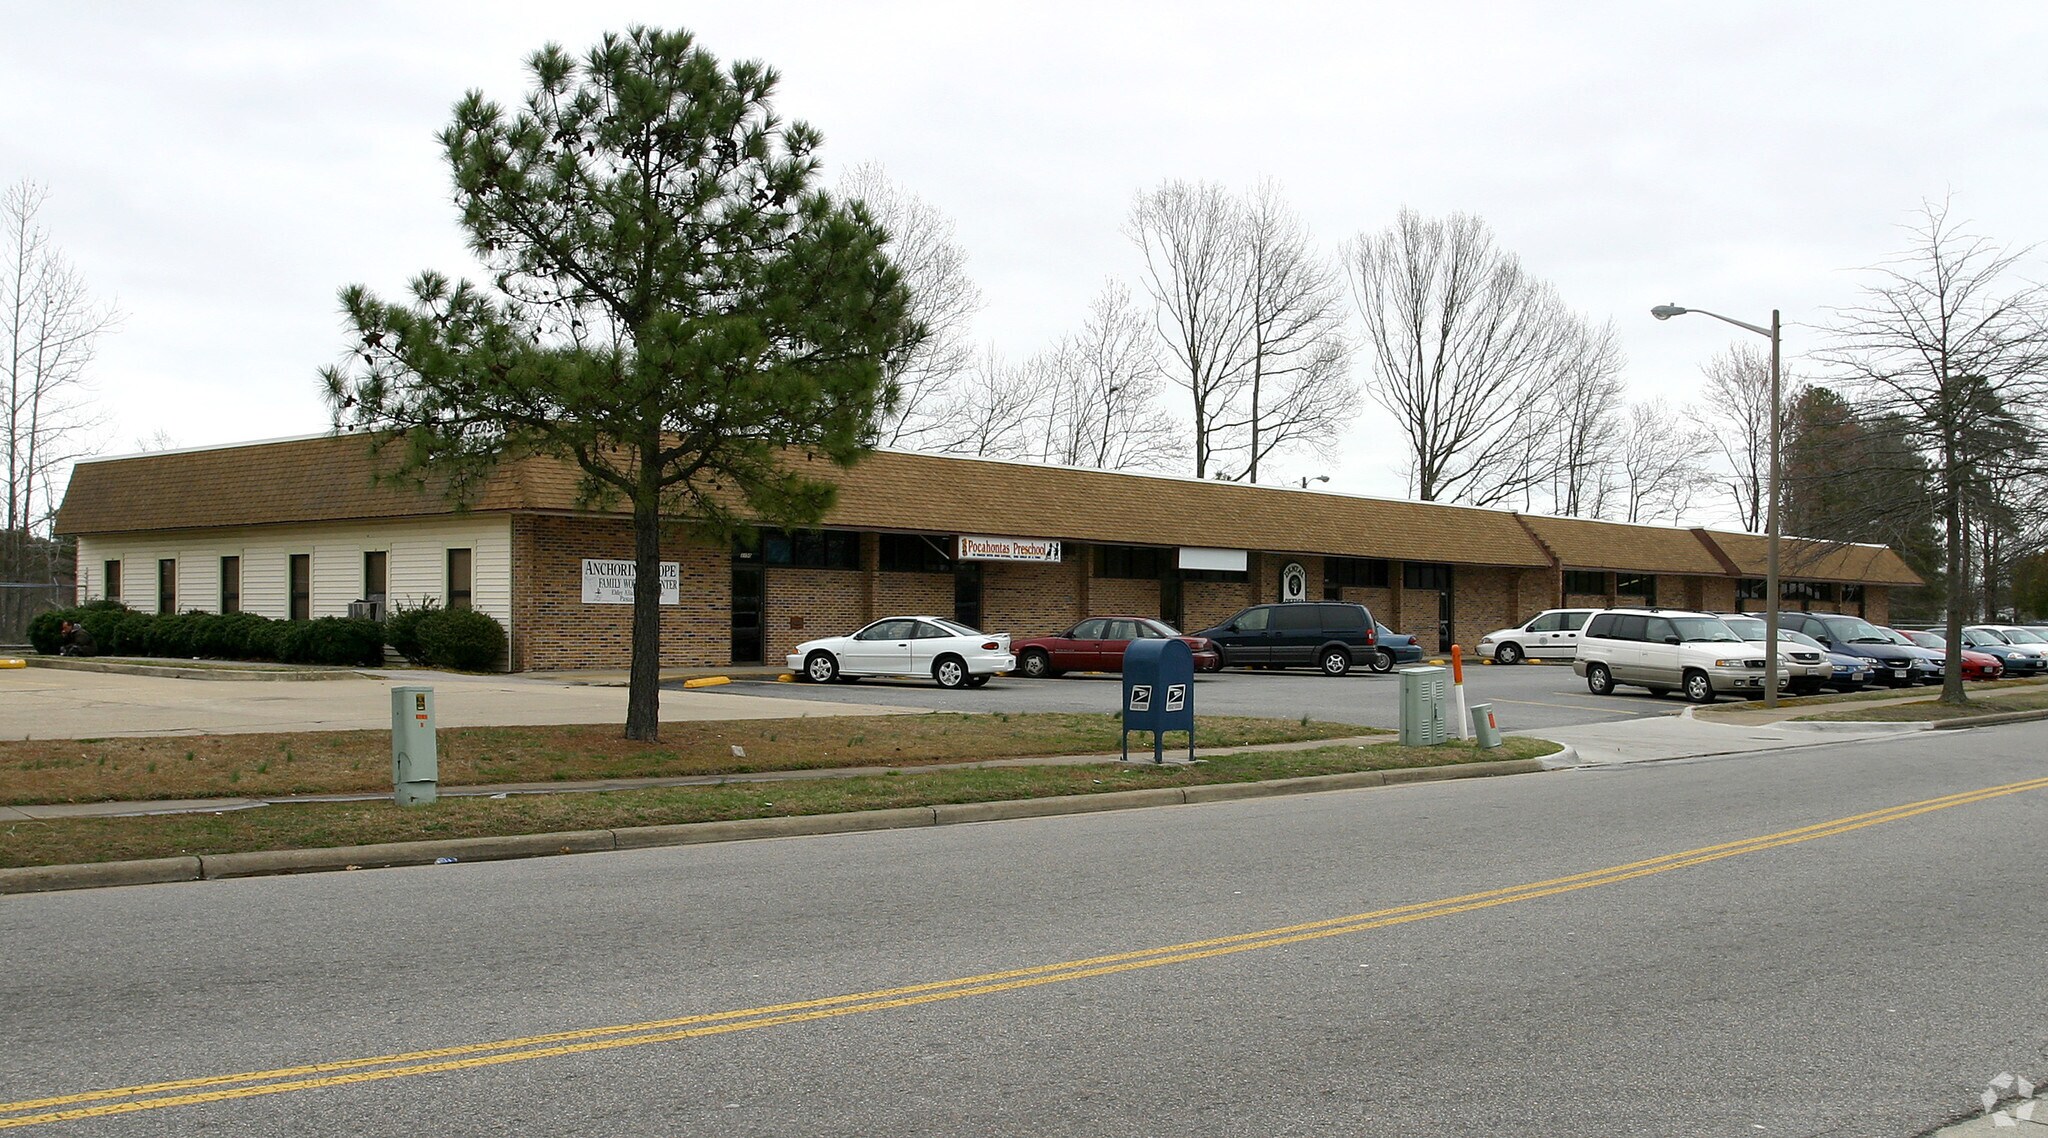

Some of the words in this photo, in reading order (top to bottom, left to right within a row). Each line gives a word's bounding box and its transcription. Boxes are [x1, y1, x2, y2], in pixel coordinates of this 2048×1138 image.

[968, 540, 1010, 554] Pocahontas
[1013, 543, 1046, 555] Preschool
[586, 561, 637, 576] ANCHORIN
[660, 565, 676, 577] OPE
[1284, 565, 1304, 578] DENTAL
[598, 578, 621, 589] FAMILY
[660, 580, 677, 589] NTER
